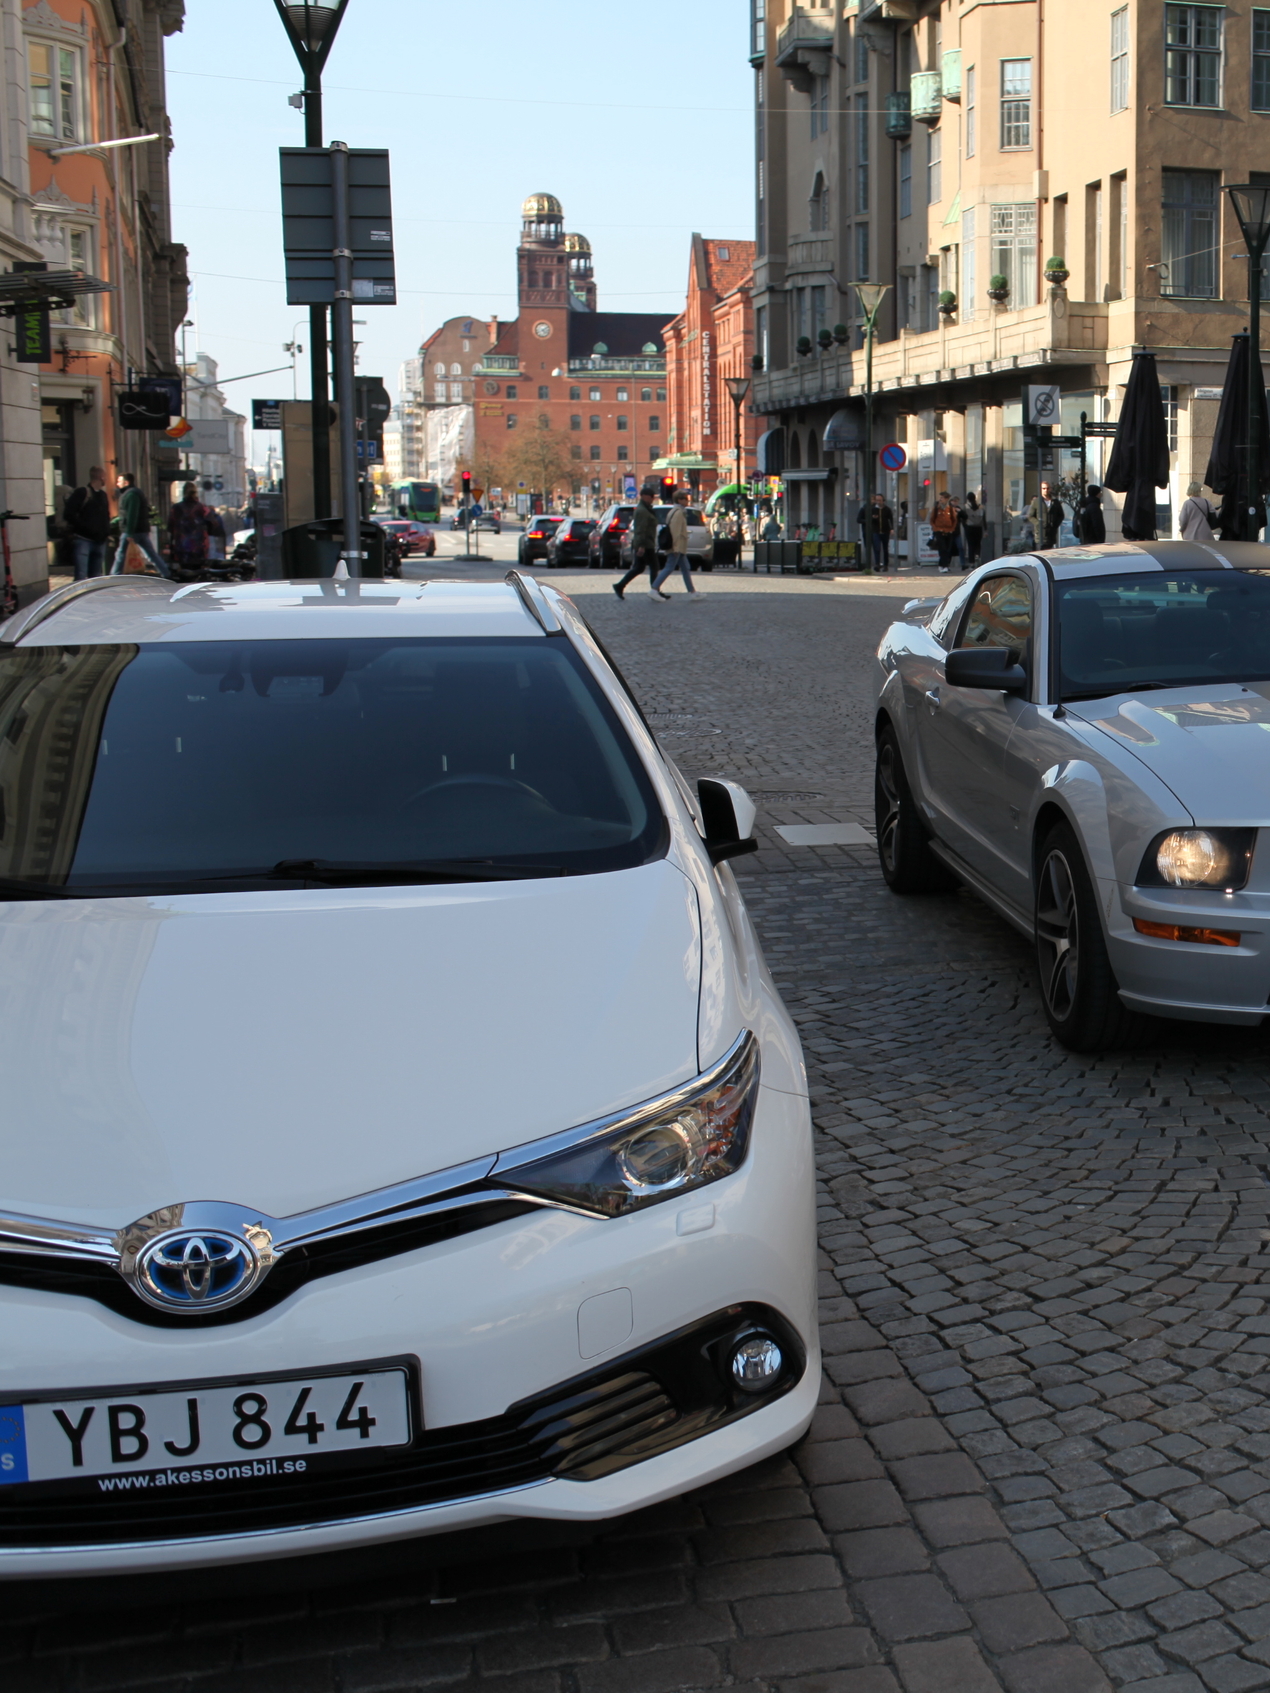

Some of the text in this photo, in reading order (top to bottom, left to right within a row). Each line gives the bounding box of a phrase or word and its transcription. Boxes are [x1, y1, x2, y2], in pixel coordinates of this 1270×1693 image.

[702, 331, 711, 436] CENTRALSTATION
[51, 1381, 377, 1468] YBJ 844
[1, 1453, 15, 1471] S
[98, 1458, 307, 1492] www.akessonsbil.se
